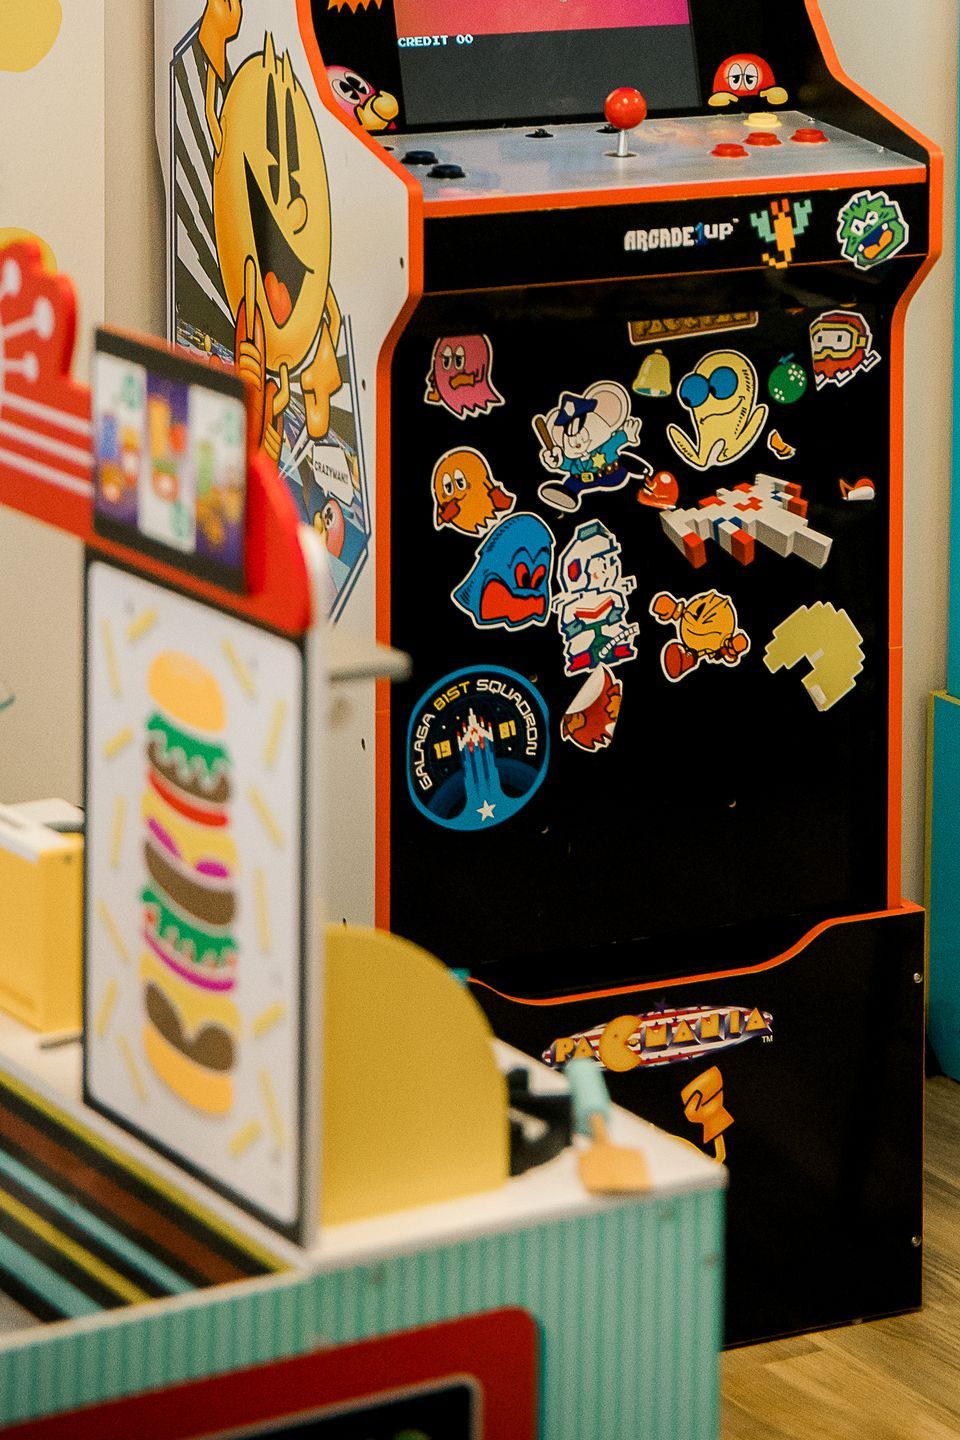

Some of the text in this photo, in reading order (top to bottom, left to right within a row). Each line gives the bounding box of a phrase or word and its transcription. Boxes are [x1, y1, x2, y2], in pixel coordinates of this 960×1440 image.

[398, 34, 473, 47] CREDIT 00
[414, 679, 538, 791] GALAGA 81ST SQUADRON
